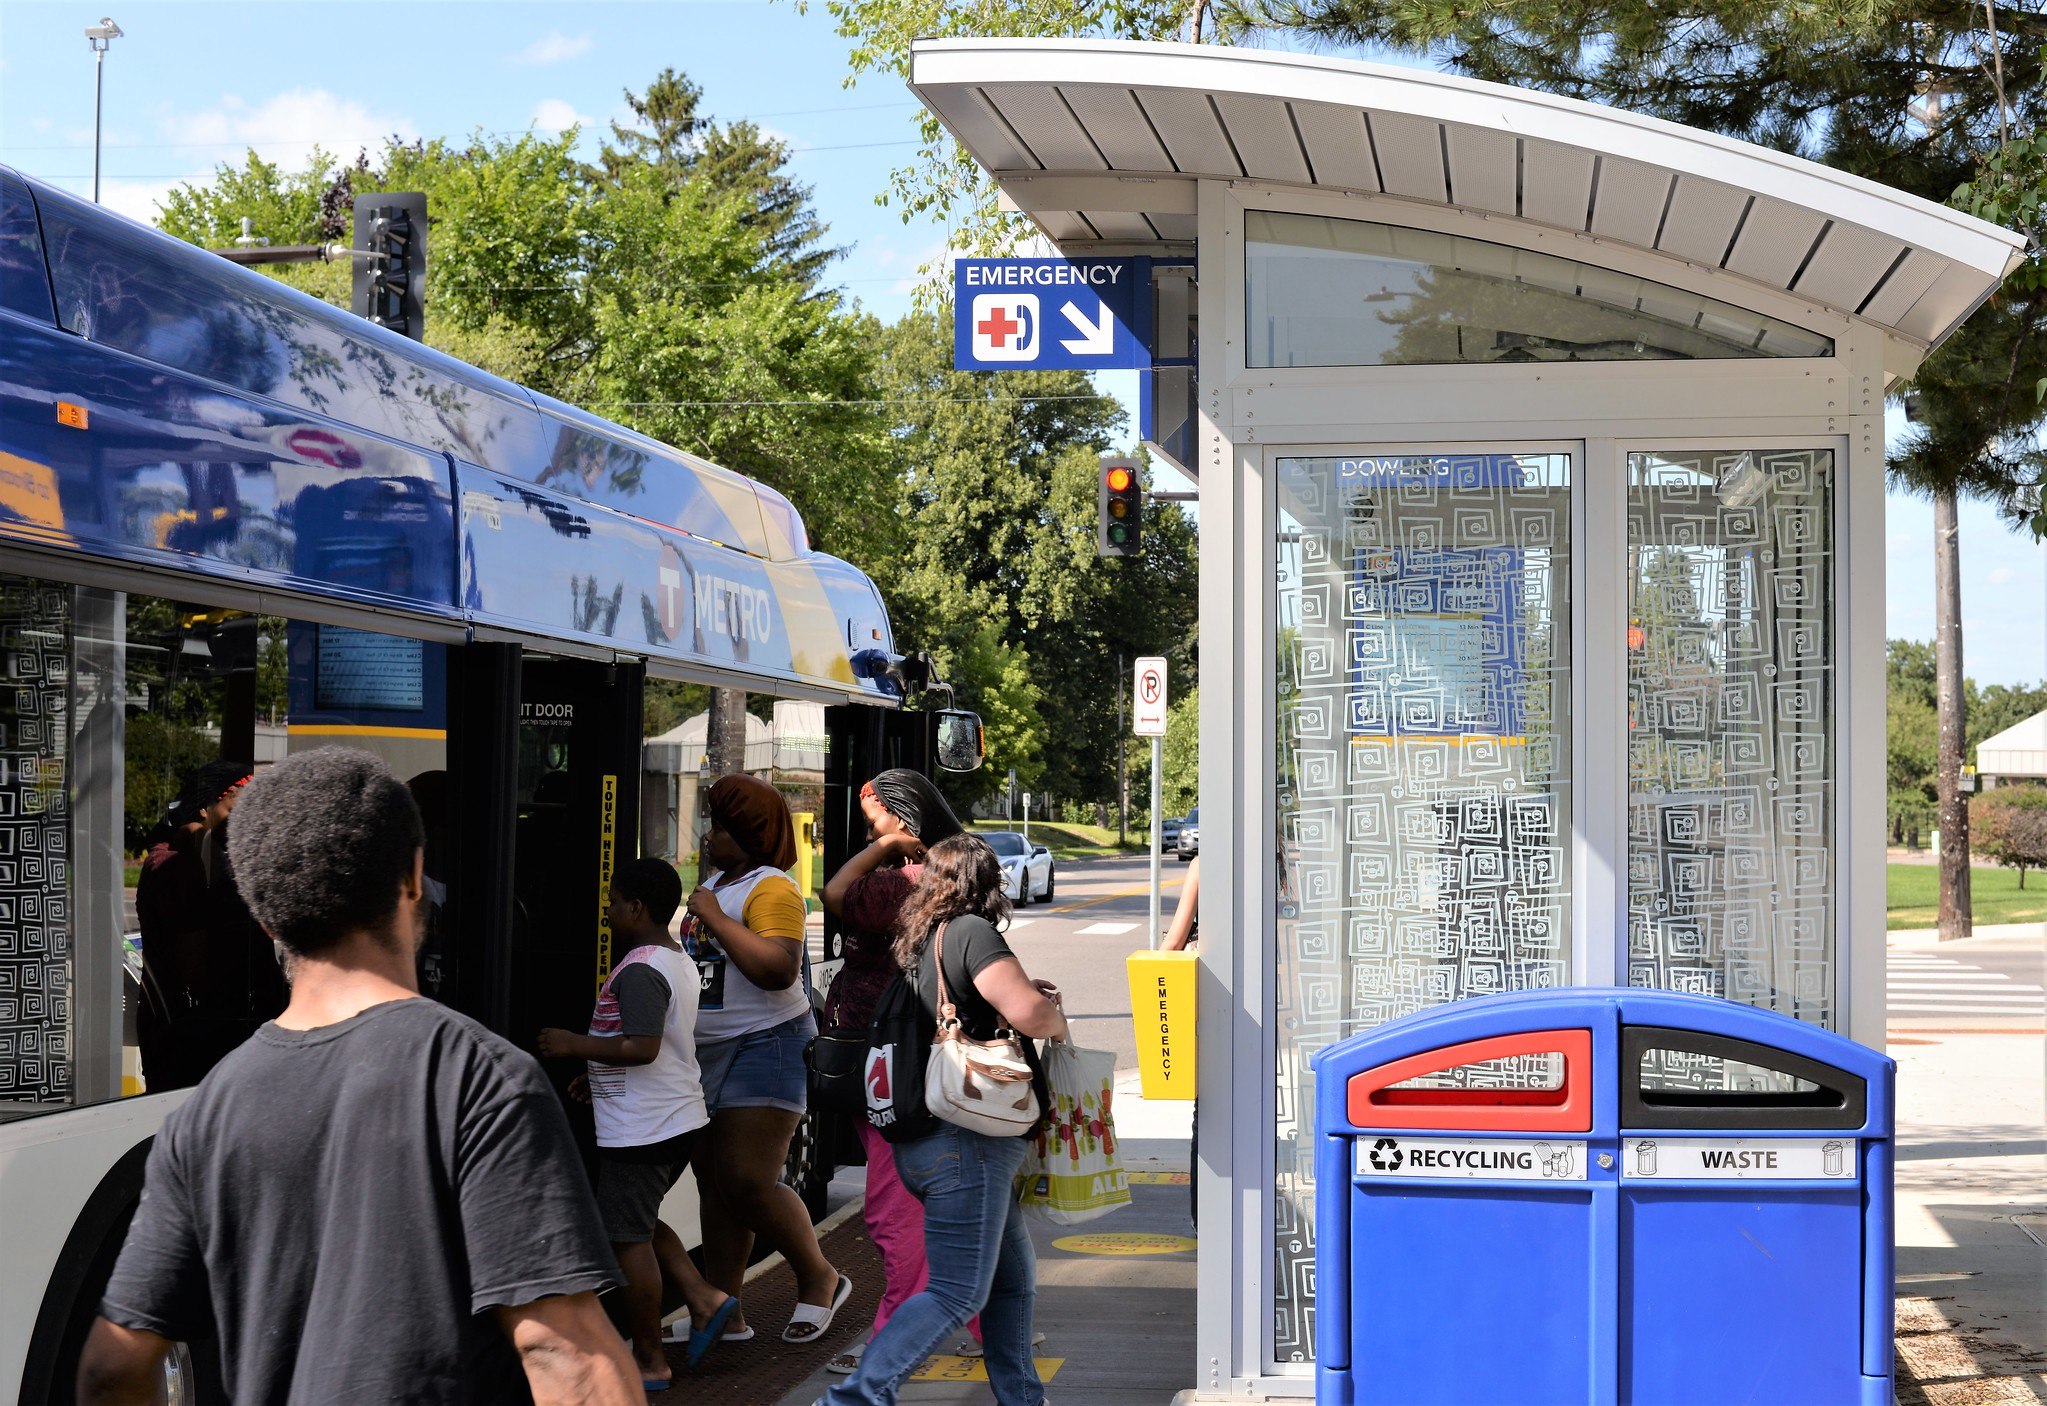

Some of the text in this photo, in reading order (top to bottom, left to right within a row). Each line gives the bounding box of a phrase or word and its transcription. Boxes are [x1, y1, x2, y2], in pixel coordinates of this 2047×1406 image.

[966, 264, 1122, 286] EMERGENCY
[1342, 458, 1449, 477] DOWLING
[694, 570, 770, 644] METRO
[520, 703, 573, 718] IT DOOR
[602, 780, 613, 882] TOUCH HERE
[600, 906, 610, 928] TO
[600, 934, 609, 976] OPEN
[1158, 976, 1171, 1080] EMERGENCY
[1410, 1149, 1532, 1170] RECYCLING
[1702, 1150, 1778, 1169] WASTE
[1091, 1172, 1129, 1196] ALD
